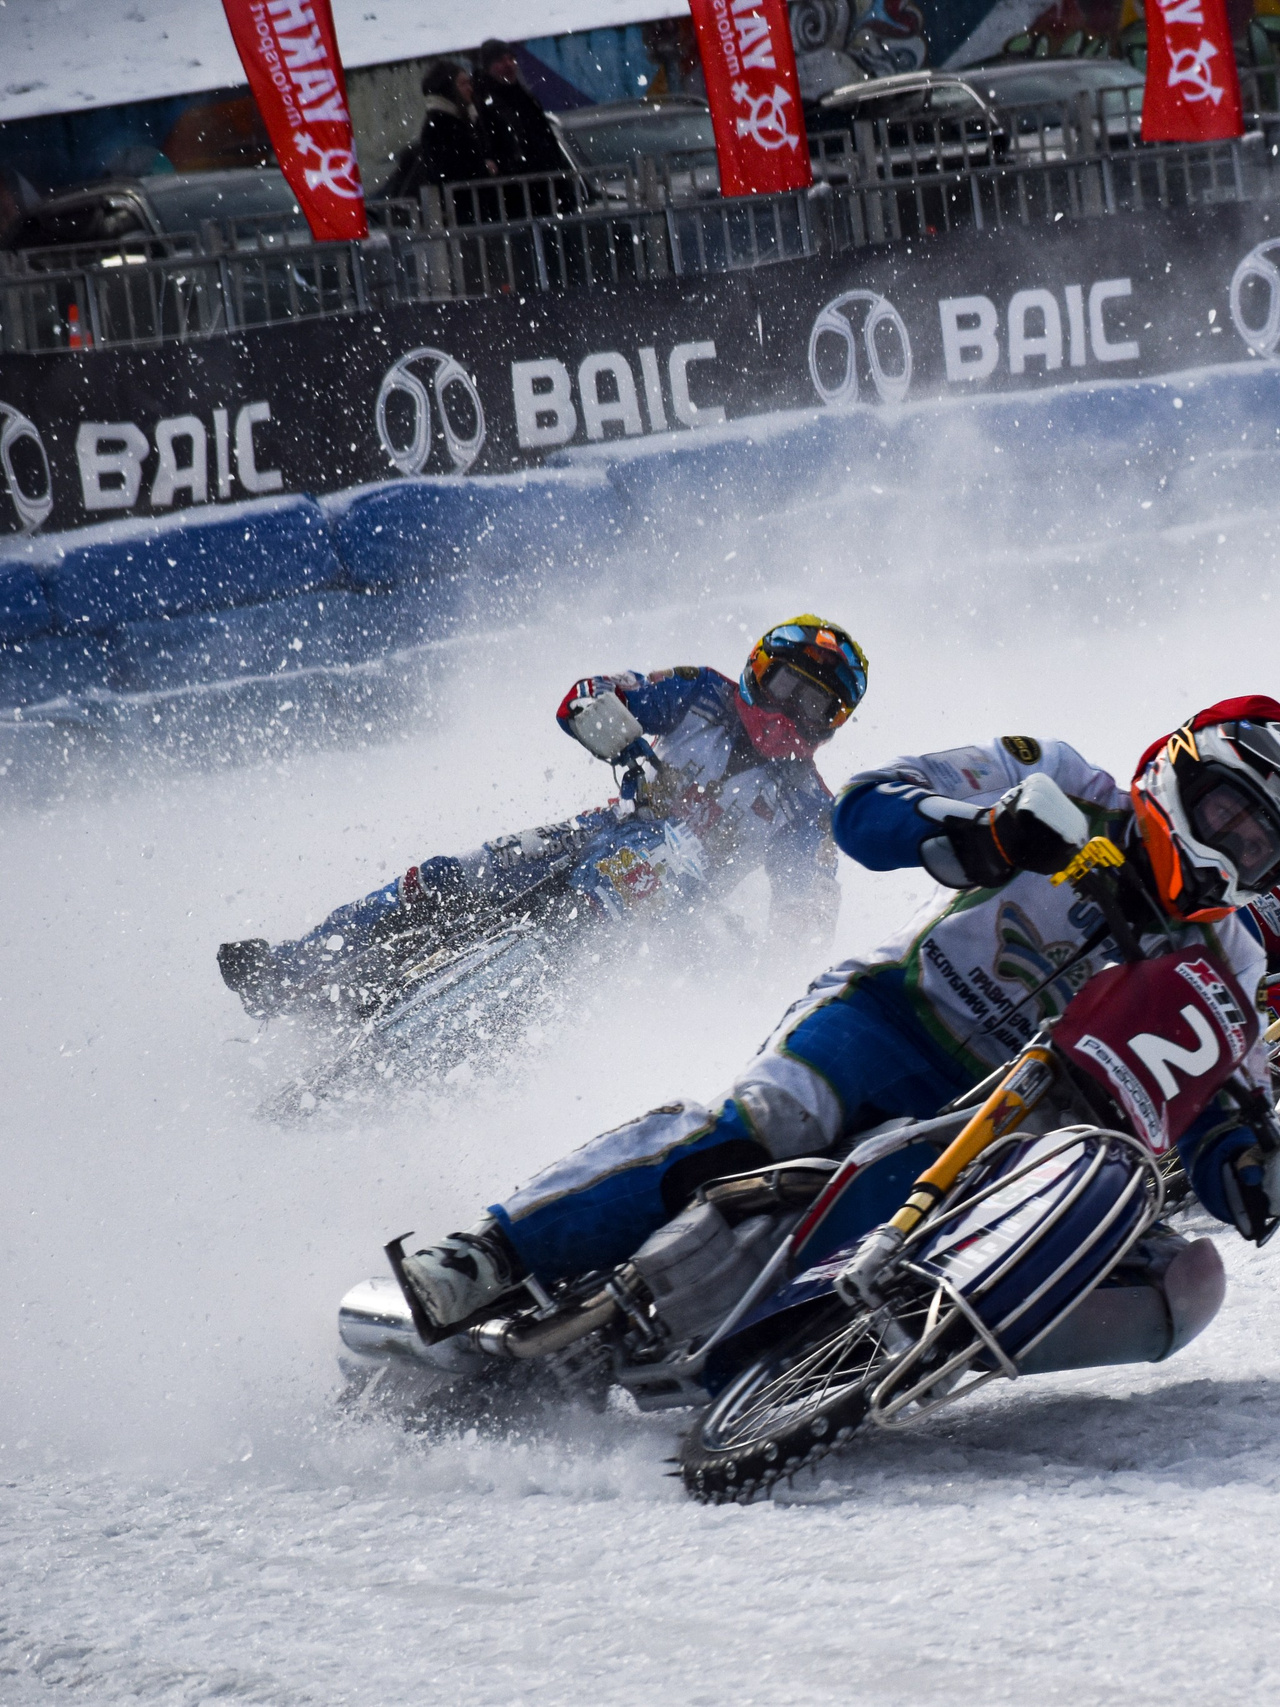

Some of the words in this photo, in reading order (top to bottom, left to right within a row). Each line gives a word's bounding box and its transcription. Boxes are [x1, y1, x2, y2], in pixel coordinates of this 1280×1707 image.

[939, 278, 1140, 382] BAIC
[512, 341, 725, 448] BAIC
[76, 403, 283, 511] BAIC
[1127, 1004, 1220, 1101] 2
